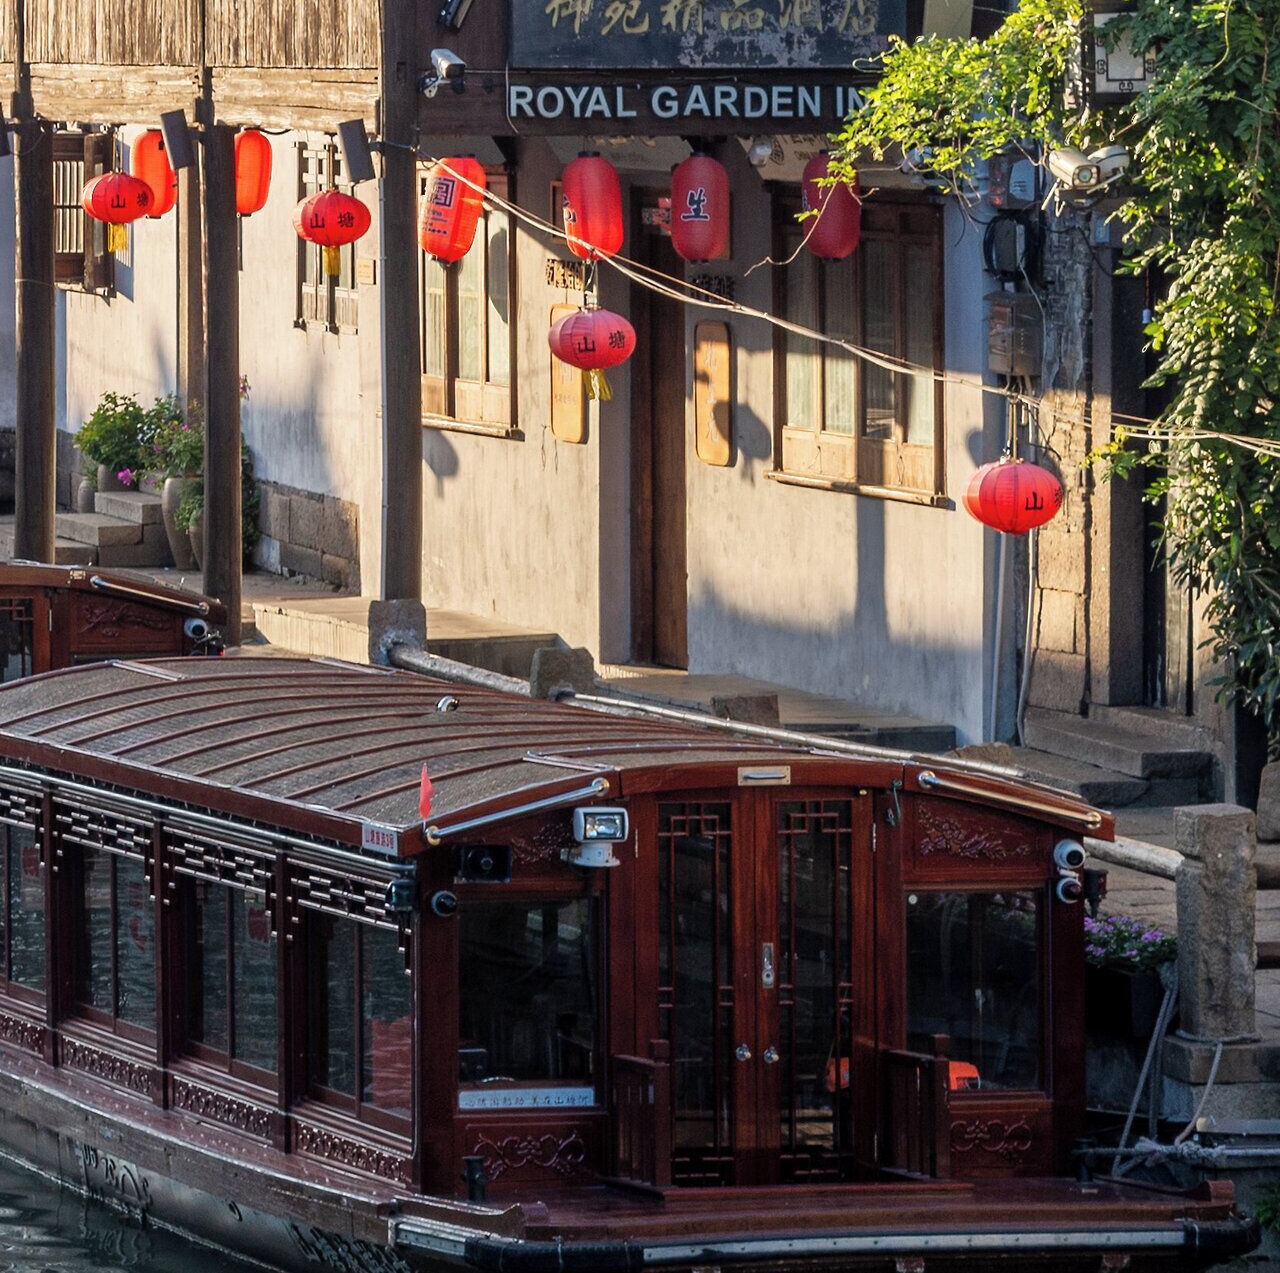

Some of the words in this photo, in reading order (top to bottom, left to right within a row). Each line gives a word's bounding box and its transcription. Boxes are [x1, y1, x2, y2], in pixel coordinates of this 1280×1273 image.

[509, 85, 638, 119] ROYAL
[651, 85, 821, 119] GARDEN
[111, 193, 149, 209] 山塘
[681, 187, 710, 221] 生
[310, 212, 355, 229] 山塘
[577, 330, 627, 353] 山塘
